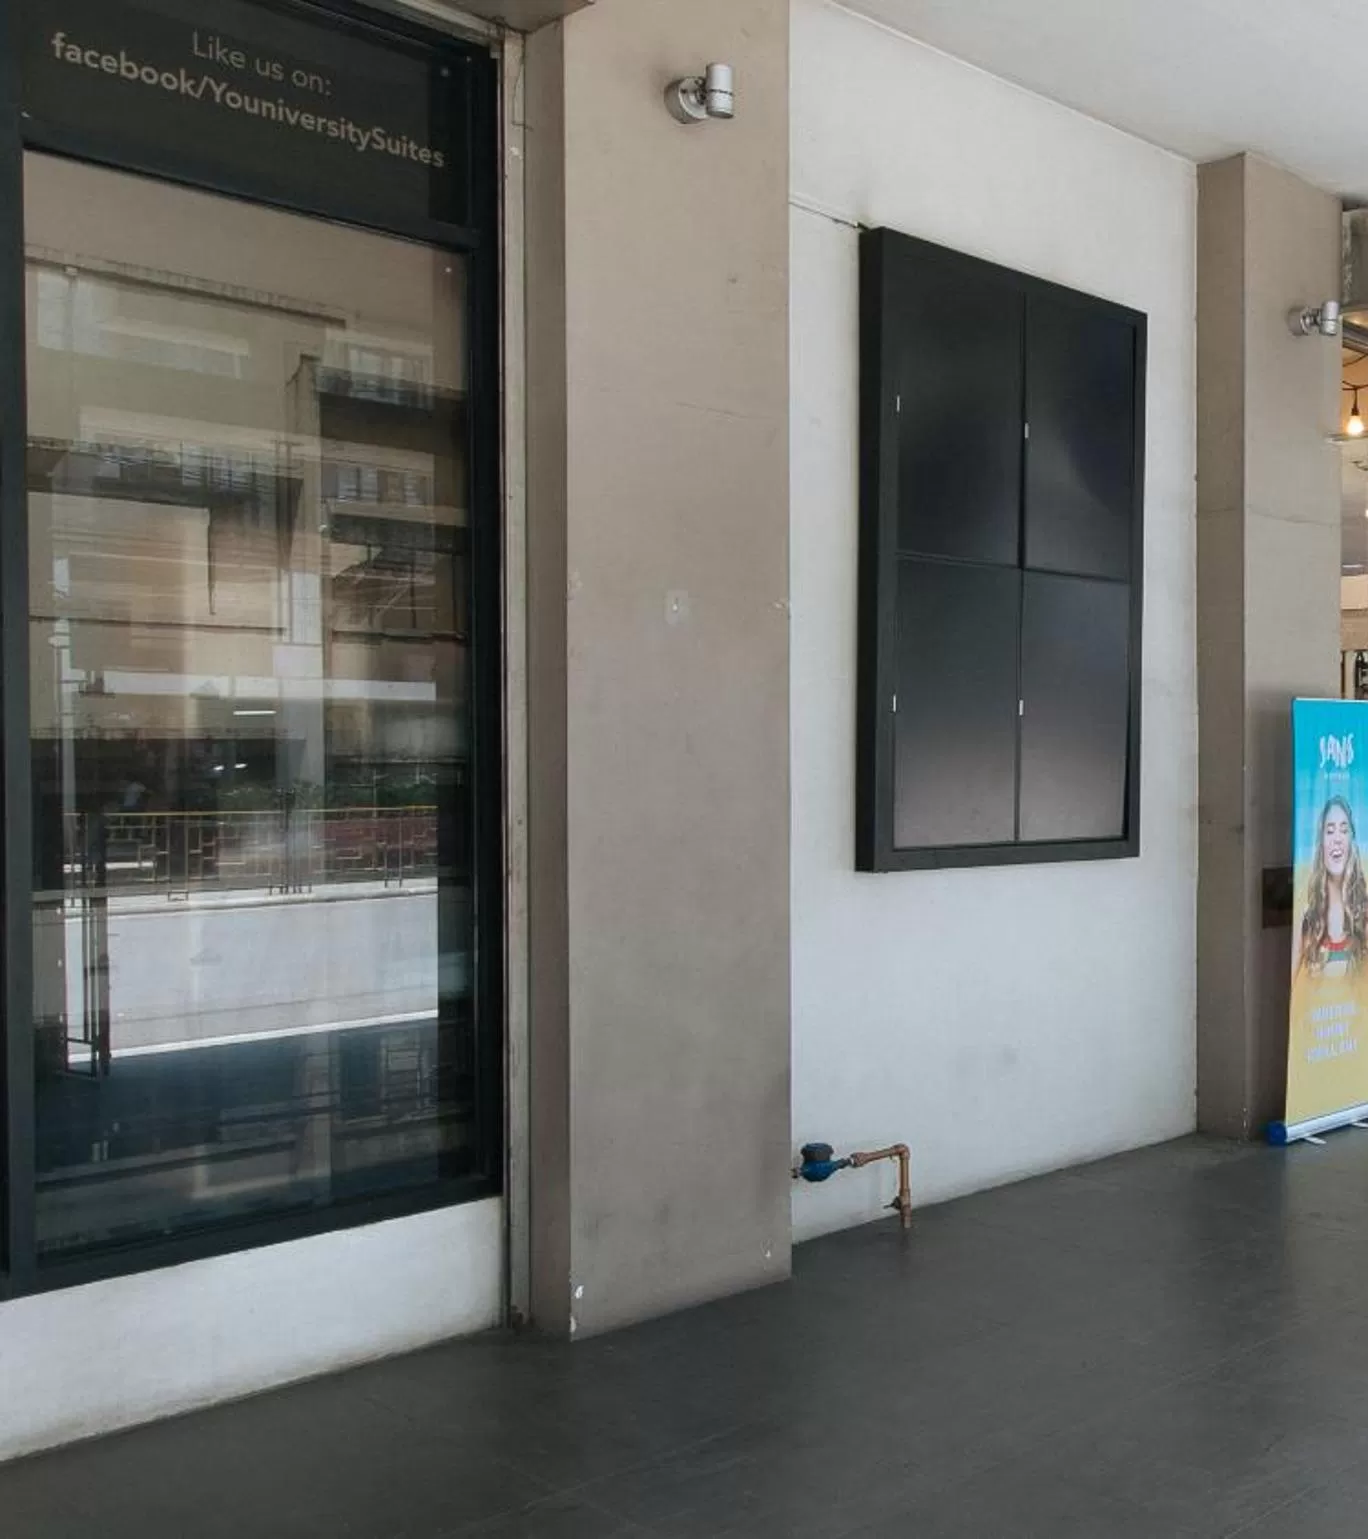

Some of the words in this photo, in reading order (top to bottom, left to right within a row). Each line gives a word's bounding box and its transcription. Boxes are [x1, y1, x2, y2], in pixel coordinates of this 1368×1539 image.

[51, 32, 445, 169] facebook/YouniversitySuites
[192, 31, 246, 69] Like
[255, 55, 284, 81] us
[291, 66, 333, 98] on:
